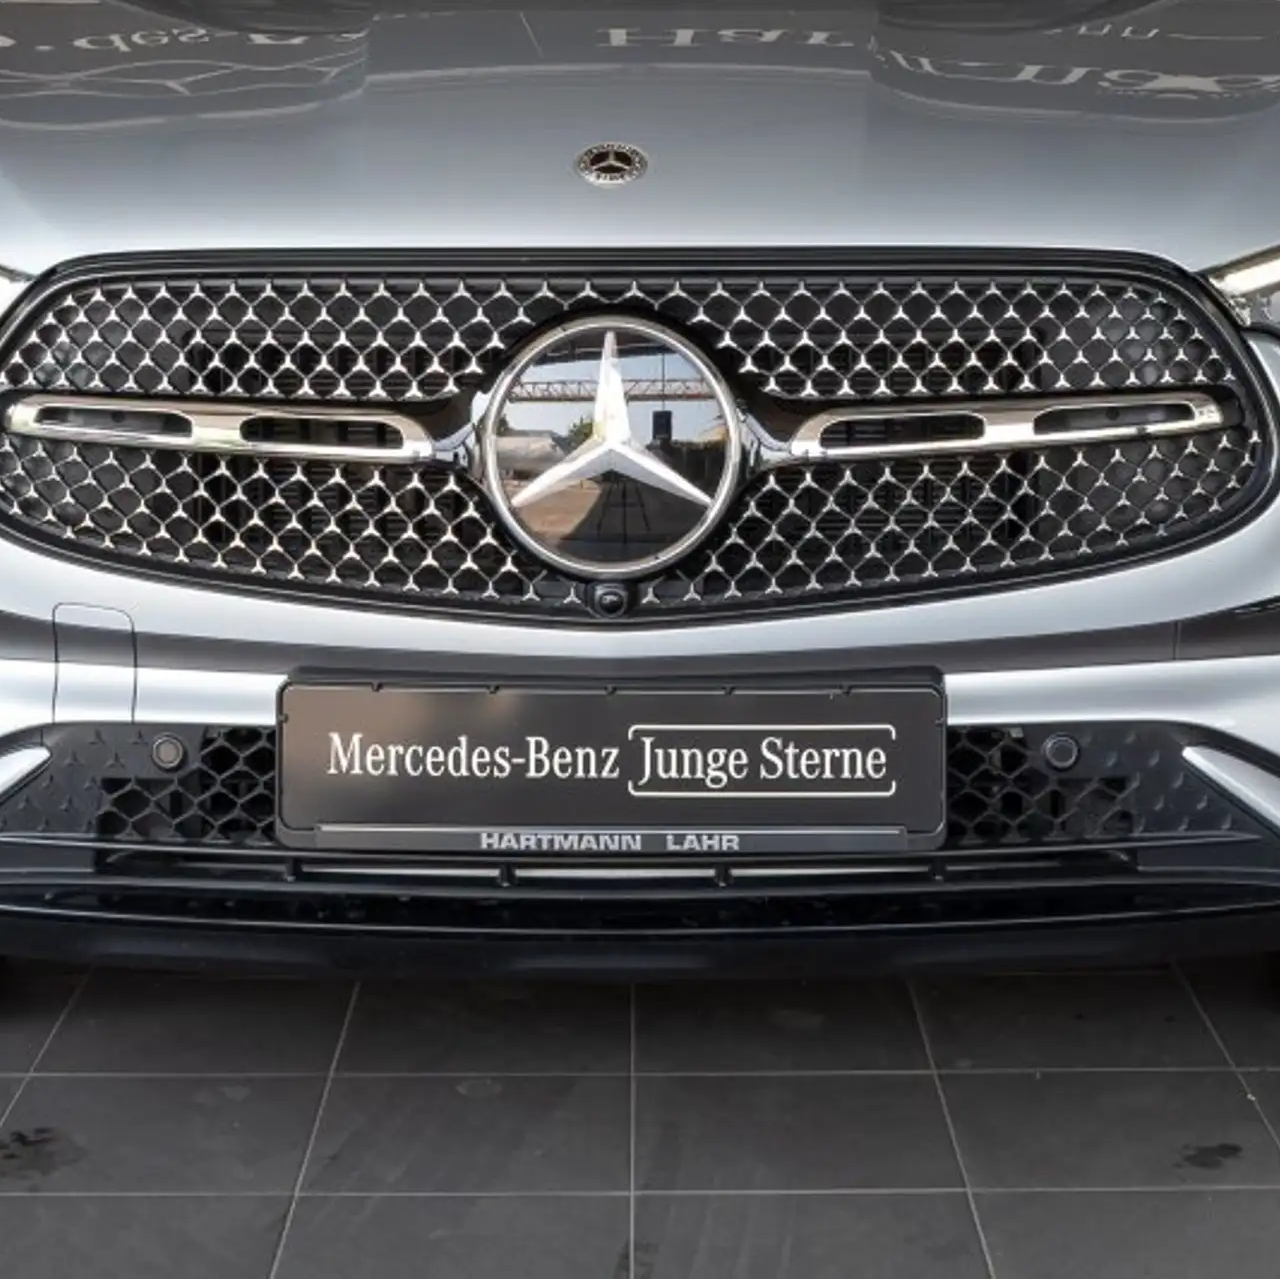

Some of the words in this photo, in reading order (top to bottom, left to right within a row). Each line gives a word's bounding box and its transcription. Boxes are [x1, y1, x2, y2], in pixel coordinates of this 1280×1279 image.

[326, 732, 620, 779] Mercedes-Benz
[638, 735, 750, 788] Junge
[760, 737, 888, 780] Sterne
[480, 833, 642, 852] HARTMANN
[666, 834, 740, 852] LAHR
